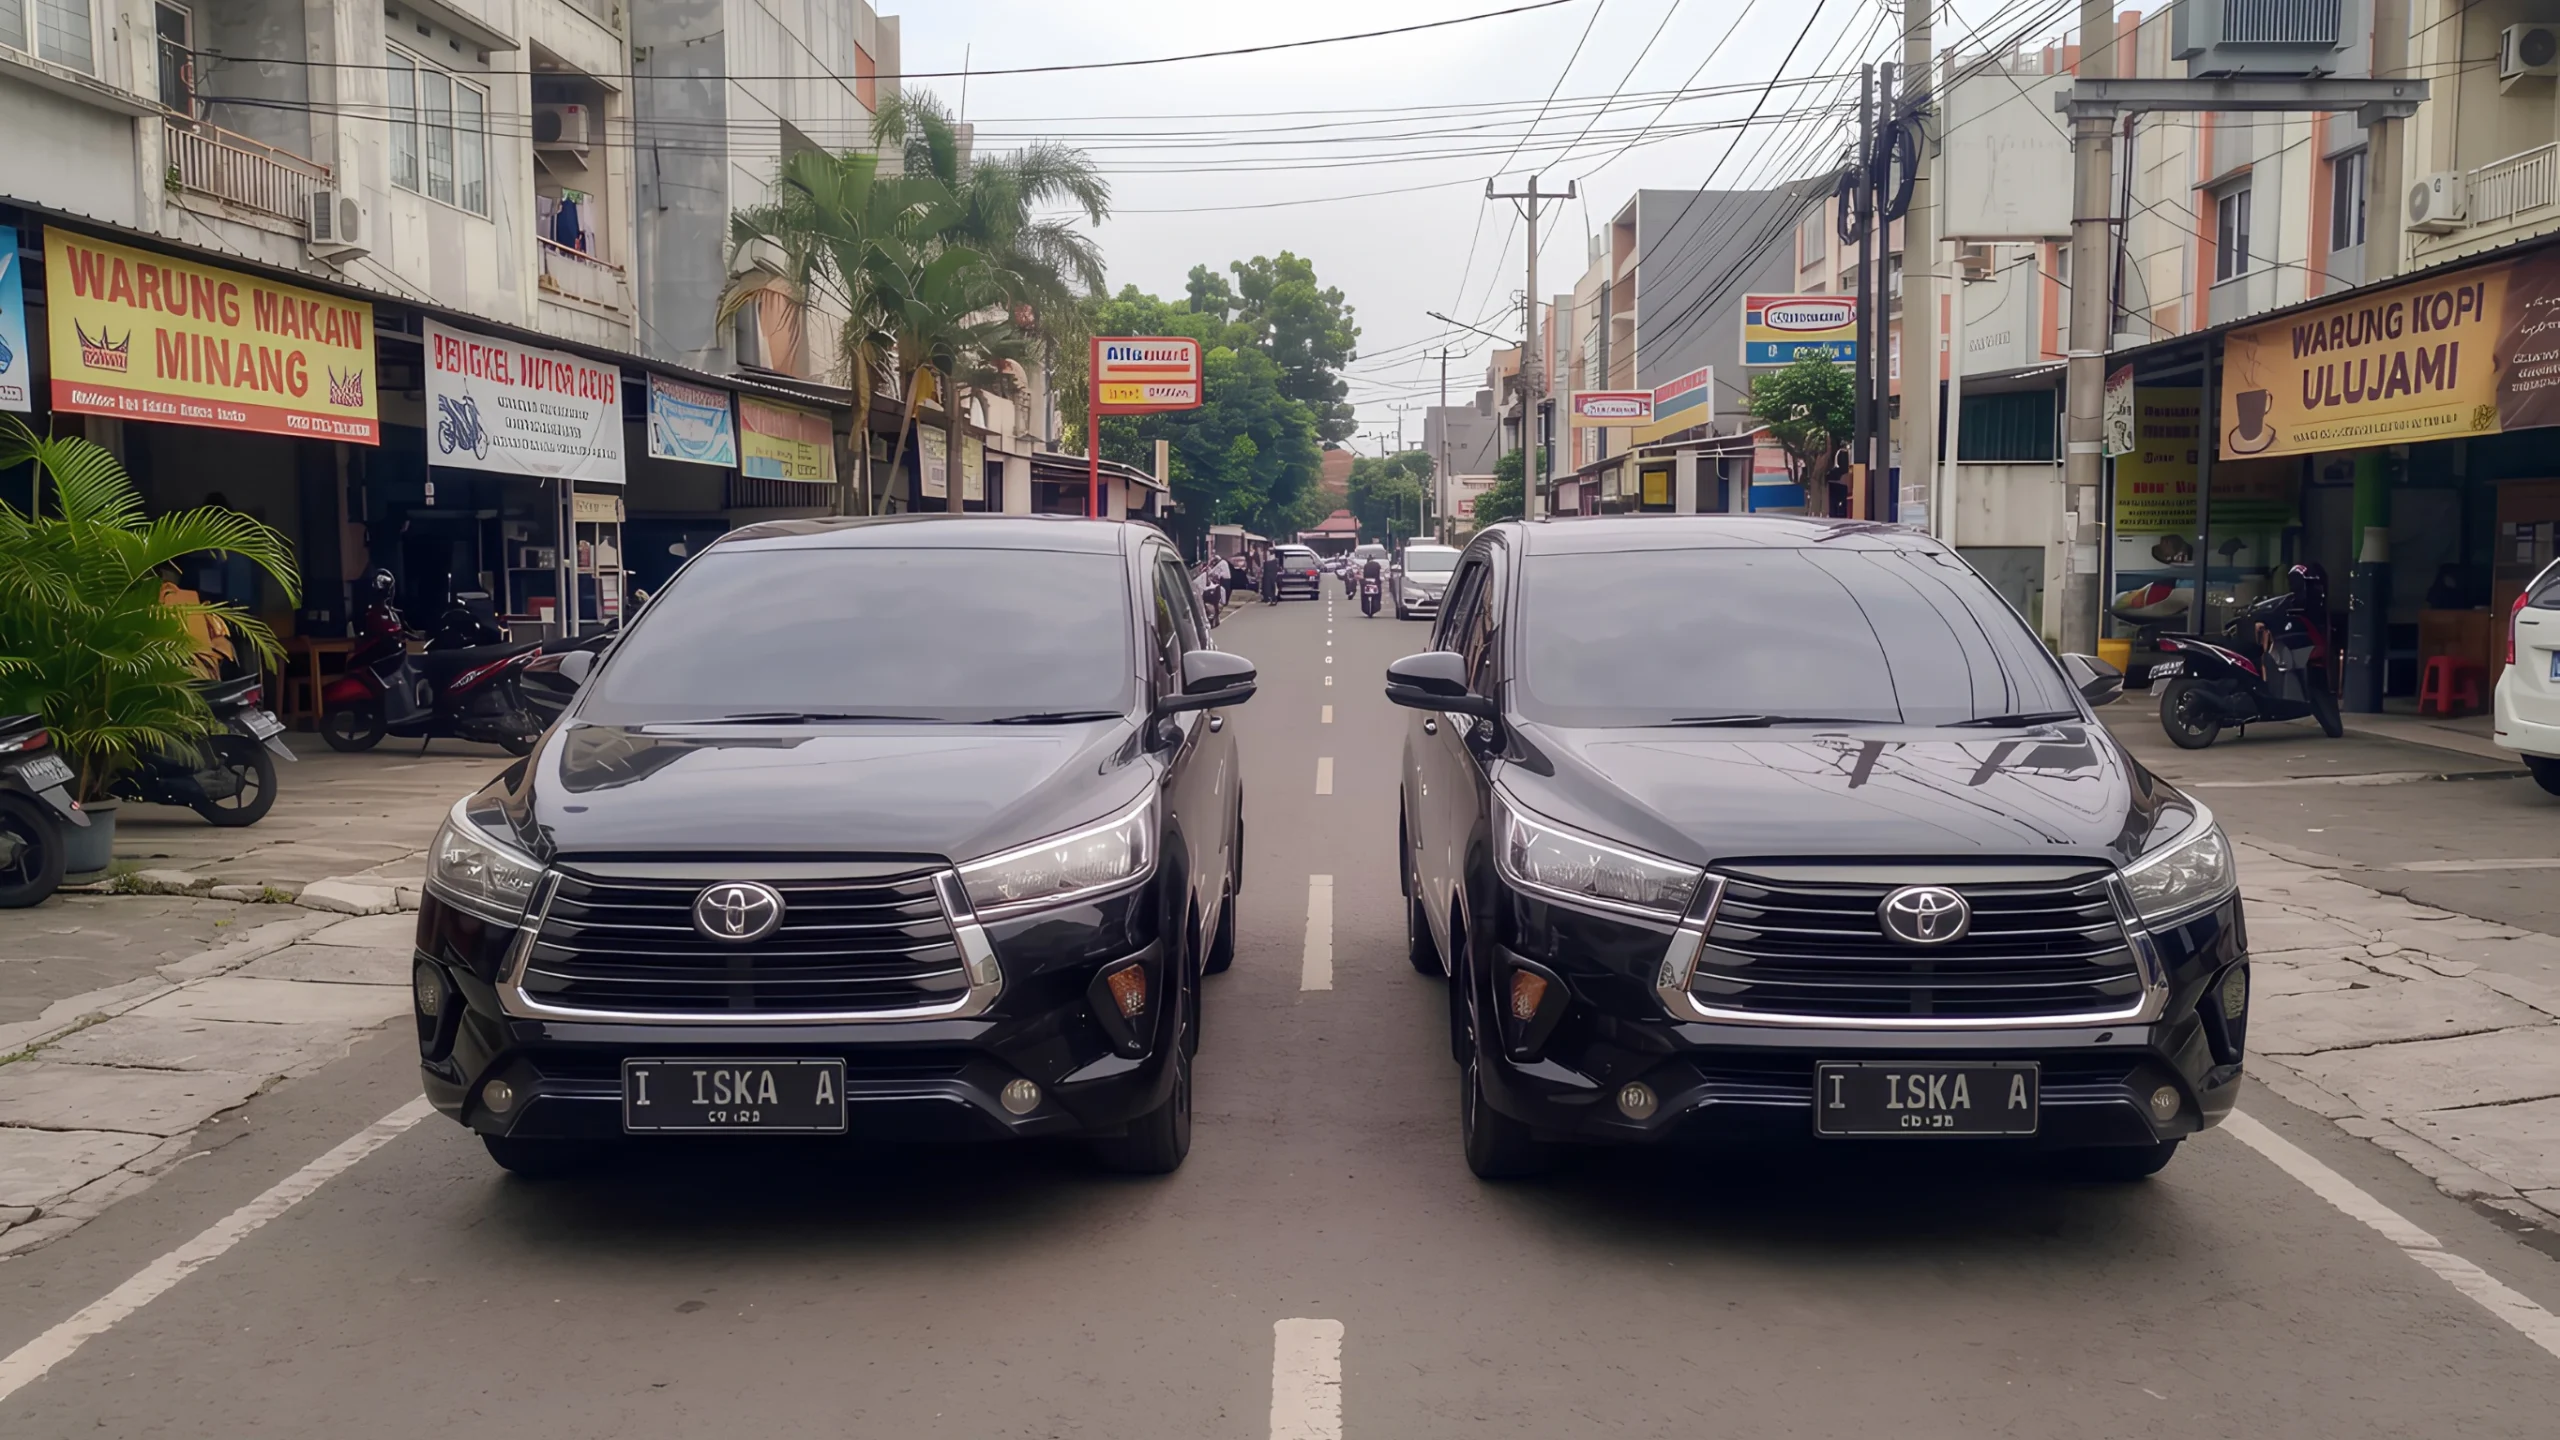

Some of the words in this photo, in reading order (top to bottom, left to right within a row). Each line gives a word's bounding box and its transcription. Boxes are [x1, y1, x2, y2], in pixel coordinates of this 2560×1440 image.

[66, 245, 241, 327] WARUNG
[252, 288, 363, 350] MAKAN
[2291, 302, 2404, 360] WARUNG
[2412, 281, 2485, 334] KOPI
[155, 327, 309, 398] MINANG
[2302, 340, 2460, 411] ULUJAMI
[692, 1069, 778, 1106] ISKA
[815, 1069, 835, 1106] A
[1886, 1073, 1971, 1110] ISKA
[2007, 1073, 2028, 1110] A
